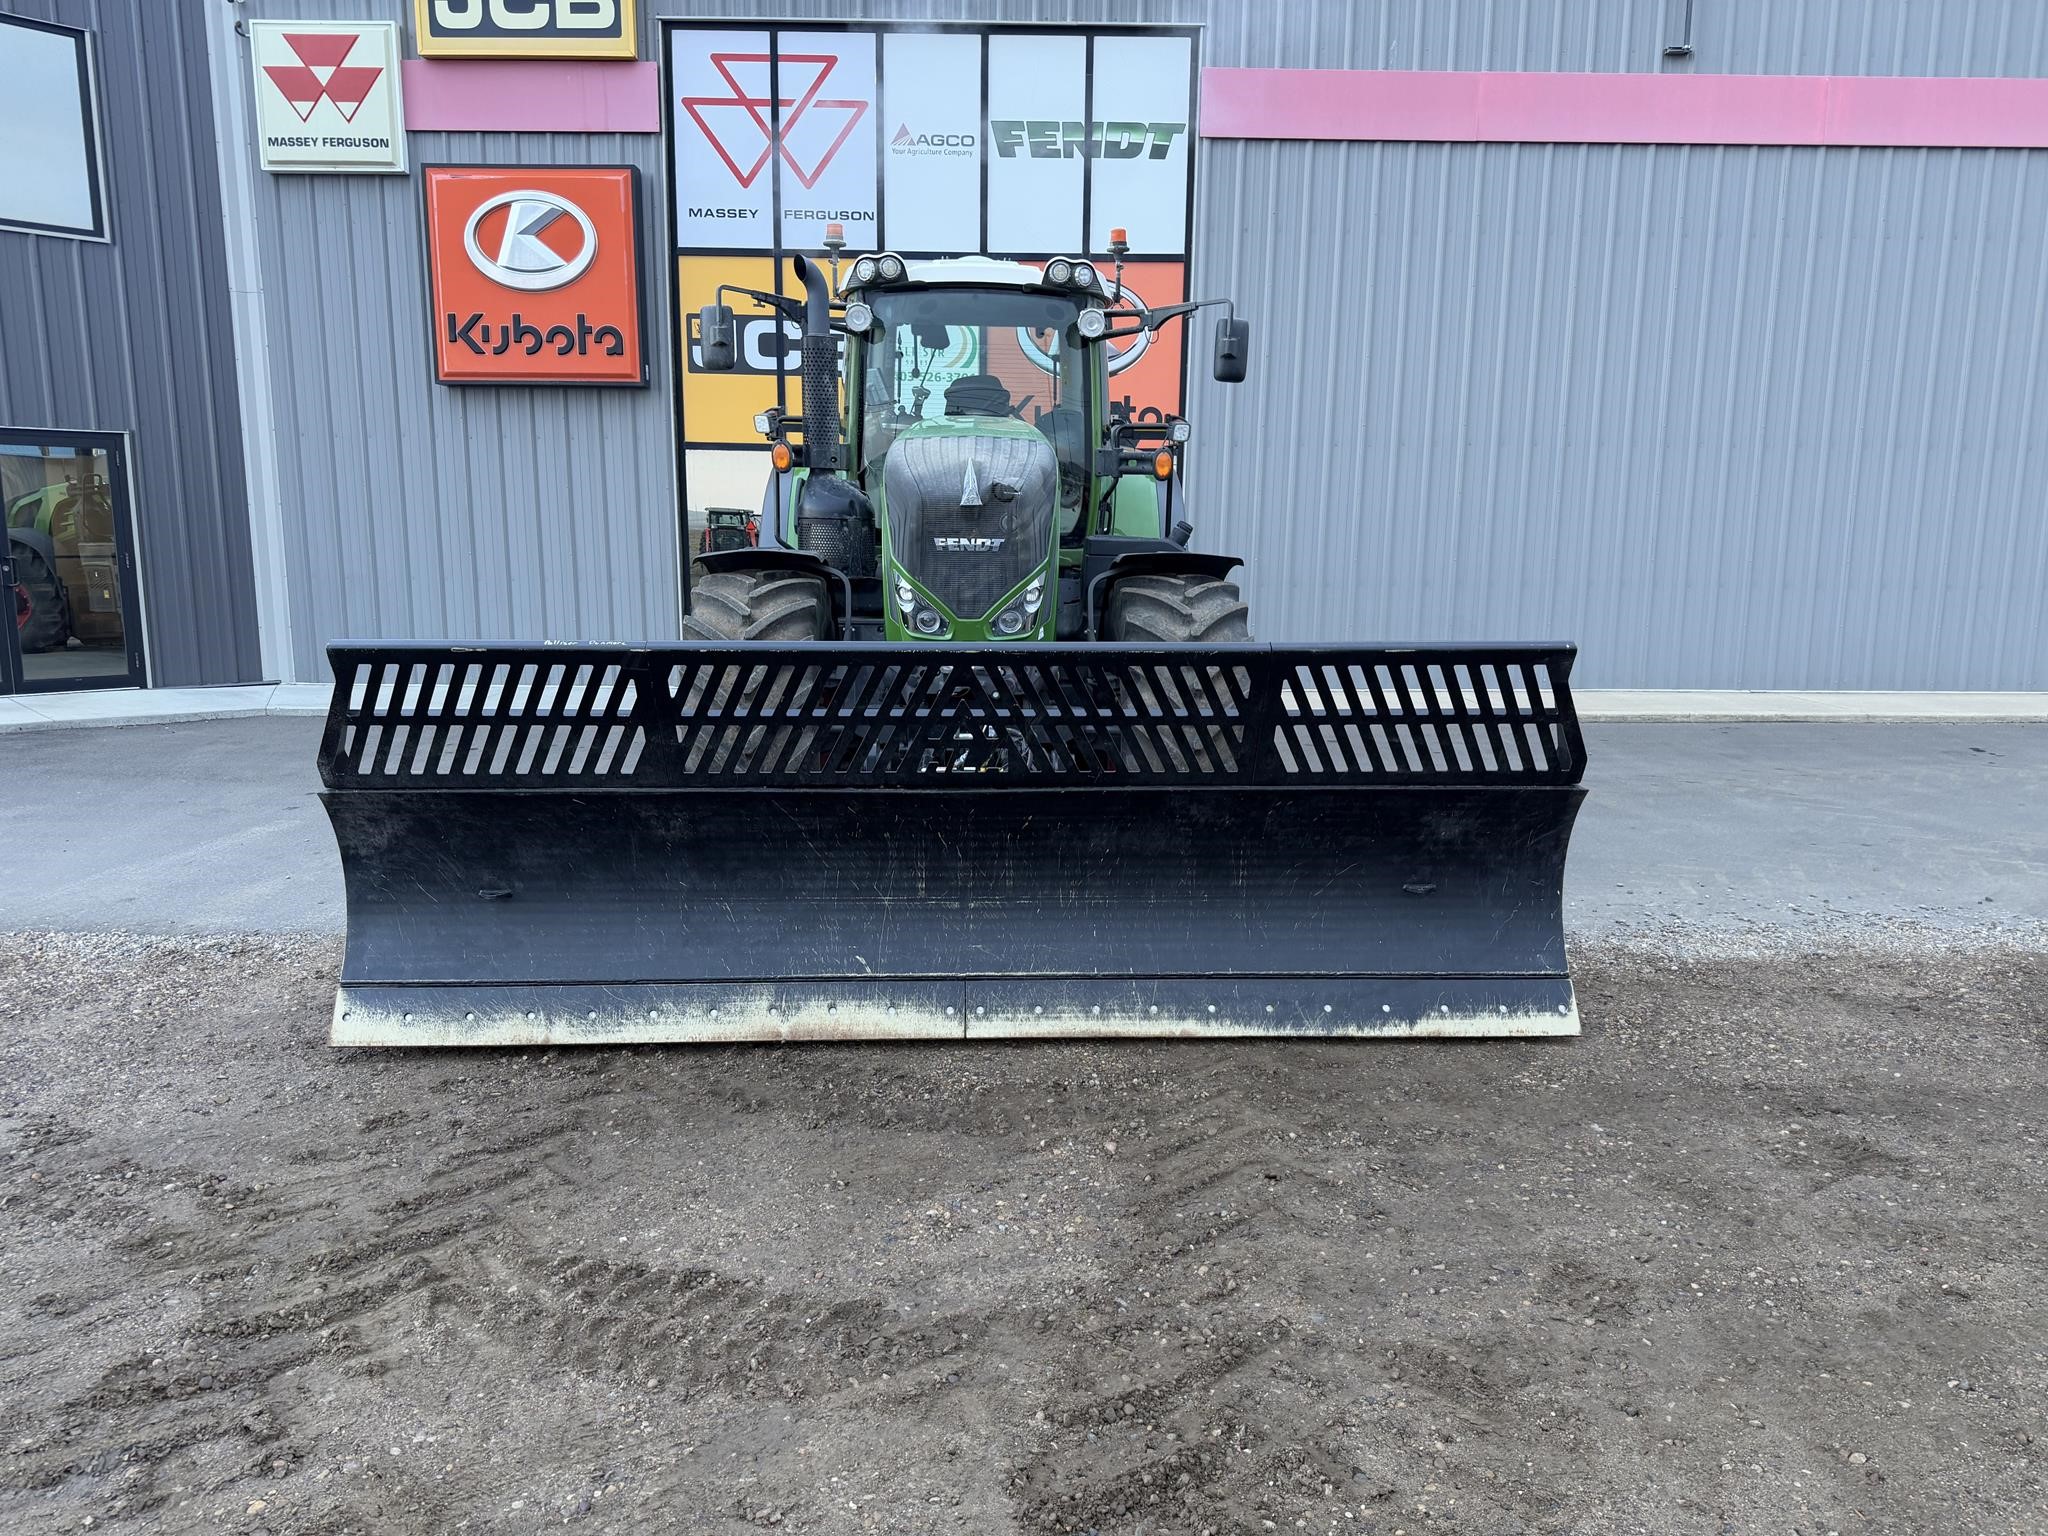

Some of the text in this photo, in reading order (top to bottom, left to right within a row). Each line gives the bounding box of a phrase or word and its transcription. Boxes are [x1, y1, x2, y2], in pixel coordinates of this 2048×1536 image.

[267, 137, 389, 148] MASSEY FERGUSON
[916, 134, 975, 147] AGCO
[991, 120, 1187, 160] FENDT
[907, 148, 942, 157] Agriculture
[943, 149, 973, 158] Company
[688, 208, 875, 221] MASSEY FERGUSON
[447, 312, 625, 356] Kubota
[934, 537, 1006, 552] FENDT
